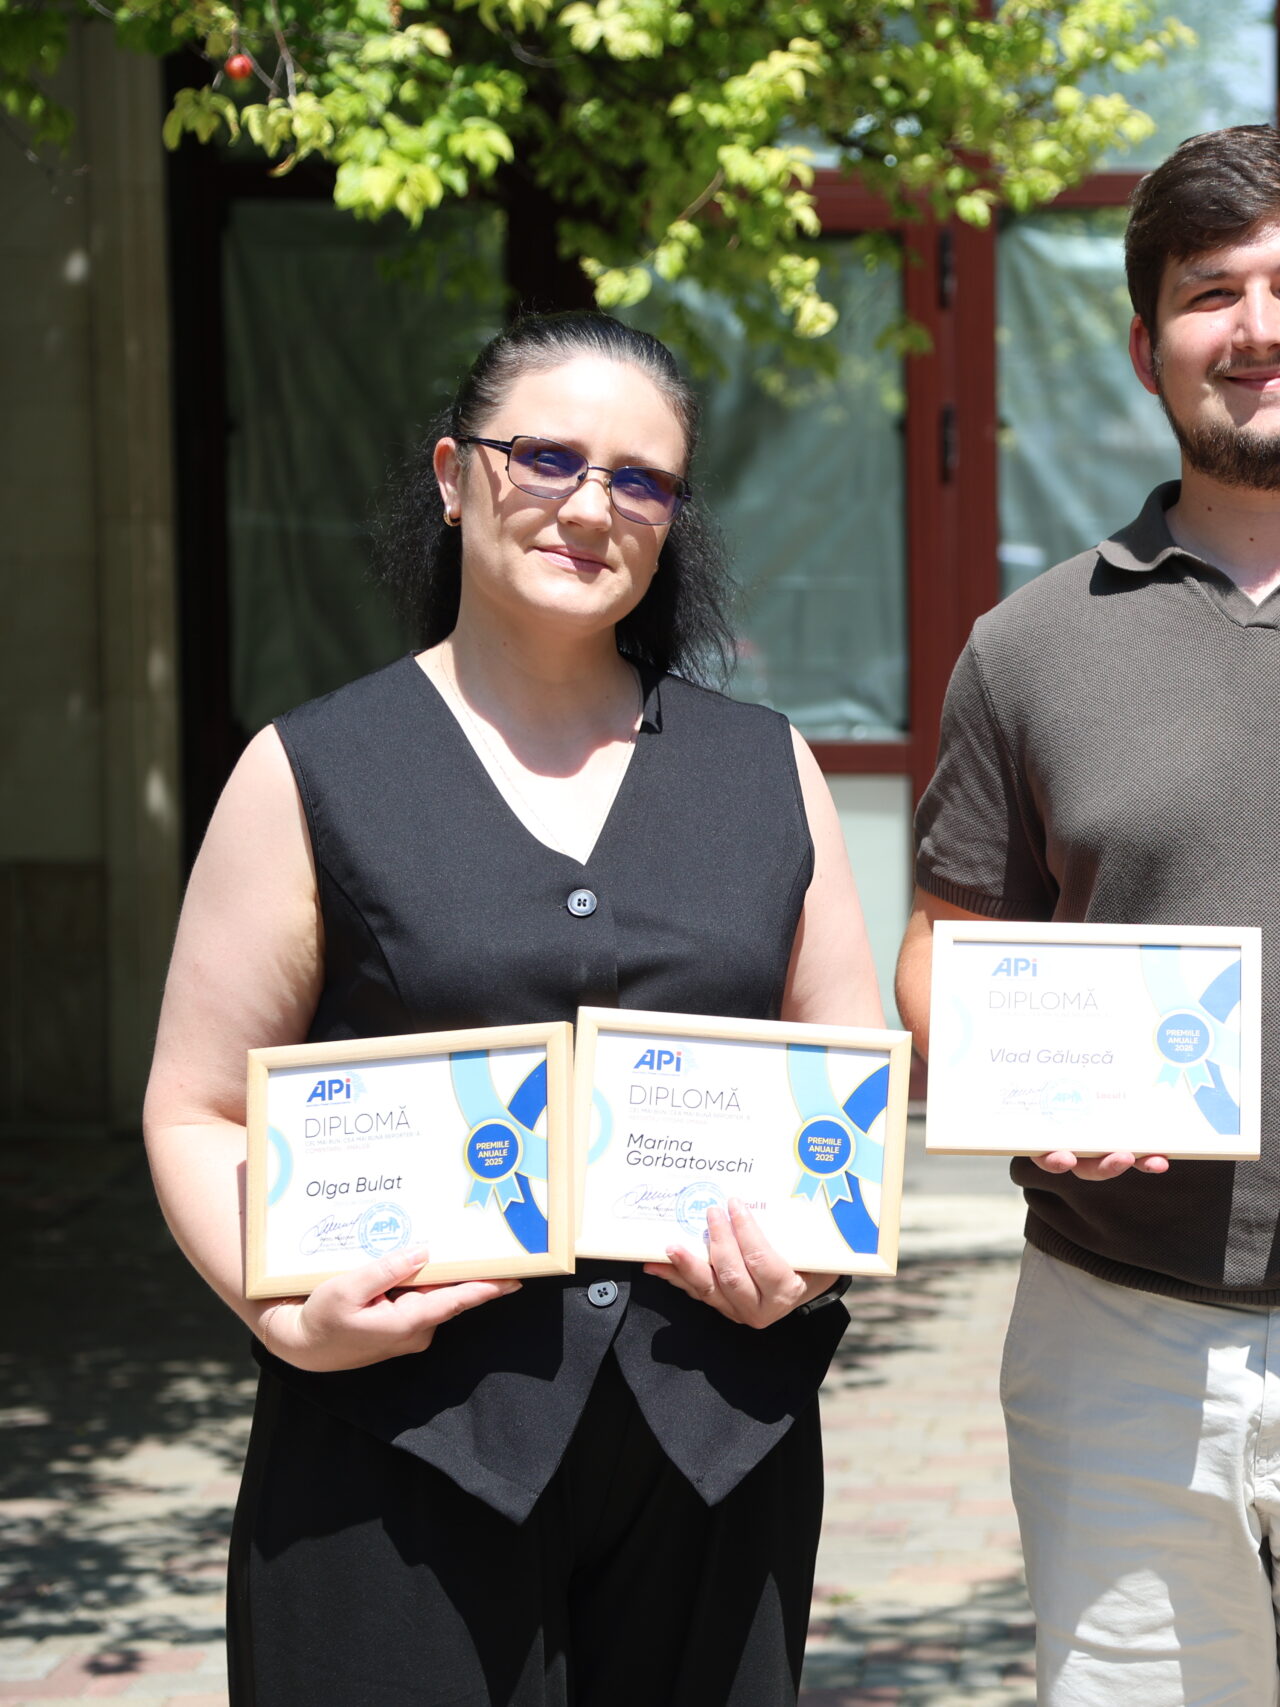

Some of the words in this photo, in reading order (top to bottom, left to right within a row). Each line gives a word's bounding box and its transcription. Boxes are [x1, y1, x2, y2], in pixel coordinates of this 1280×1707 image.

[988, 987, 1099, 1011] DIPLOMĂ
[1165, 1028, 1201, 1038] PREMIILE
[1167, 1036, 1199, 1045] ANUALE
[1173, 1043, 1195, 1052] 2025
[989, 1048, 1030, 1065] Vlad
[1037, 1047, 1115, 1068] Gălușcă
[629, 1084, 742, 1112] DIPLOMĂ
[304, 1105, 411, 1138] DIPLOMĂ
[475, 1140, 510, 1150] PREMIILE
[627, 1133, 693, 1152] Marina
[807, 1136, 842, 1147] PREMIILE
[477, 1148, 508, 1158] ANUALE
[808, 1144, 840, 1154] ANUALE
[484, 1157, 504, 1167] 2025
[626, 1151, 753, 1174] Gorbatovschi
[815, 1153, 834, 1162] 2025
[306, 1179, 350, 1200] Olga
[356, 1174, 402, 1193] Bulat
